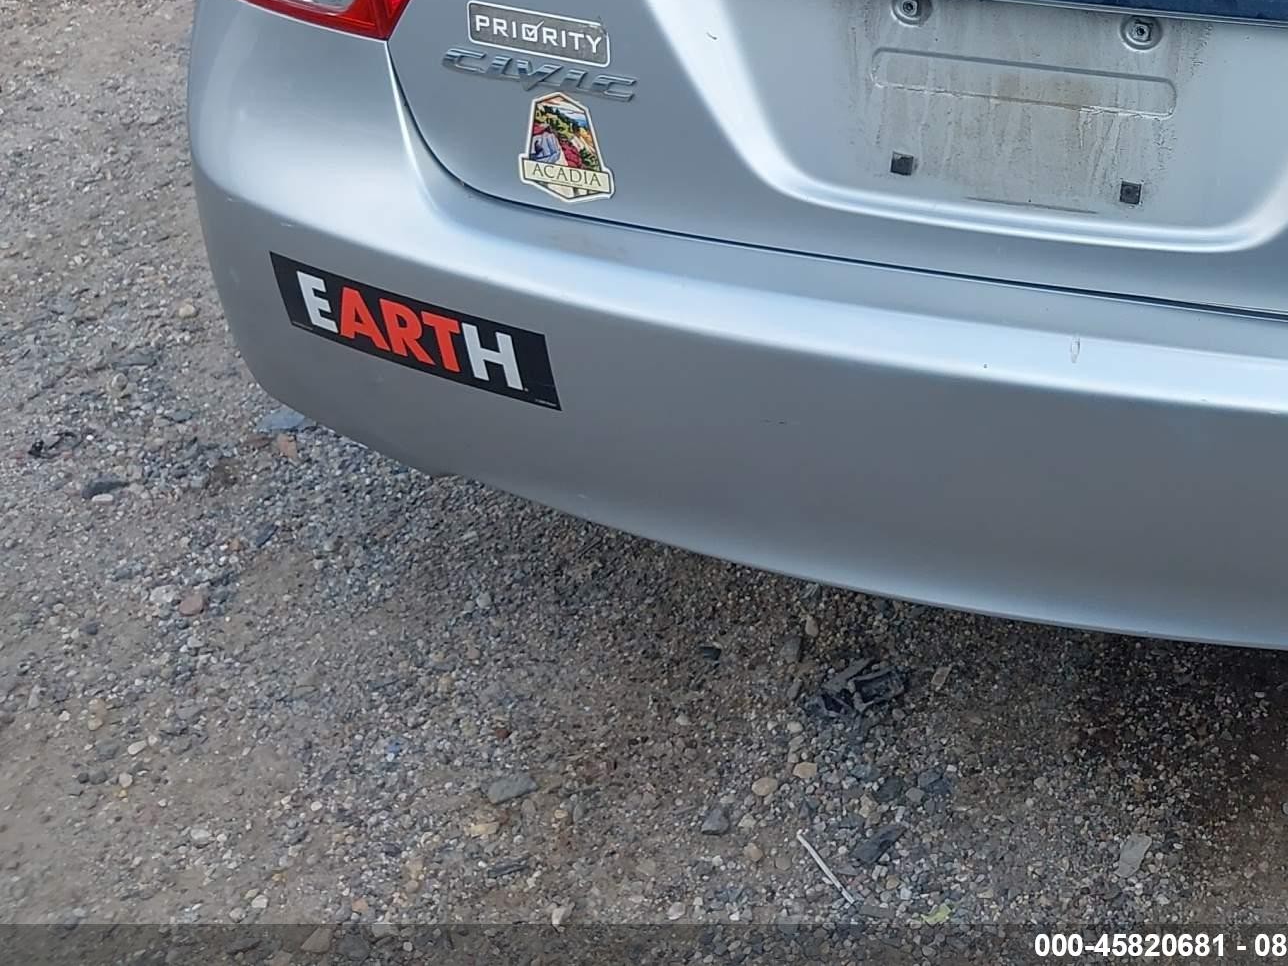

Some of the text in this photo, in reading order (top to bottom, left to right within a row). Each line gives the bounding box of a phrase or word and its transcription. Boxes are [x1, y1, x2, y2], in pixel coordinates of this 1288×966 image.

[474, 14, 603, 54] PRIORITY
[442, 48, 639, 102] CIVIC
[532, 162, 602, 187] ACADIA
[296, 270, 523, 391] EARTH
